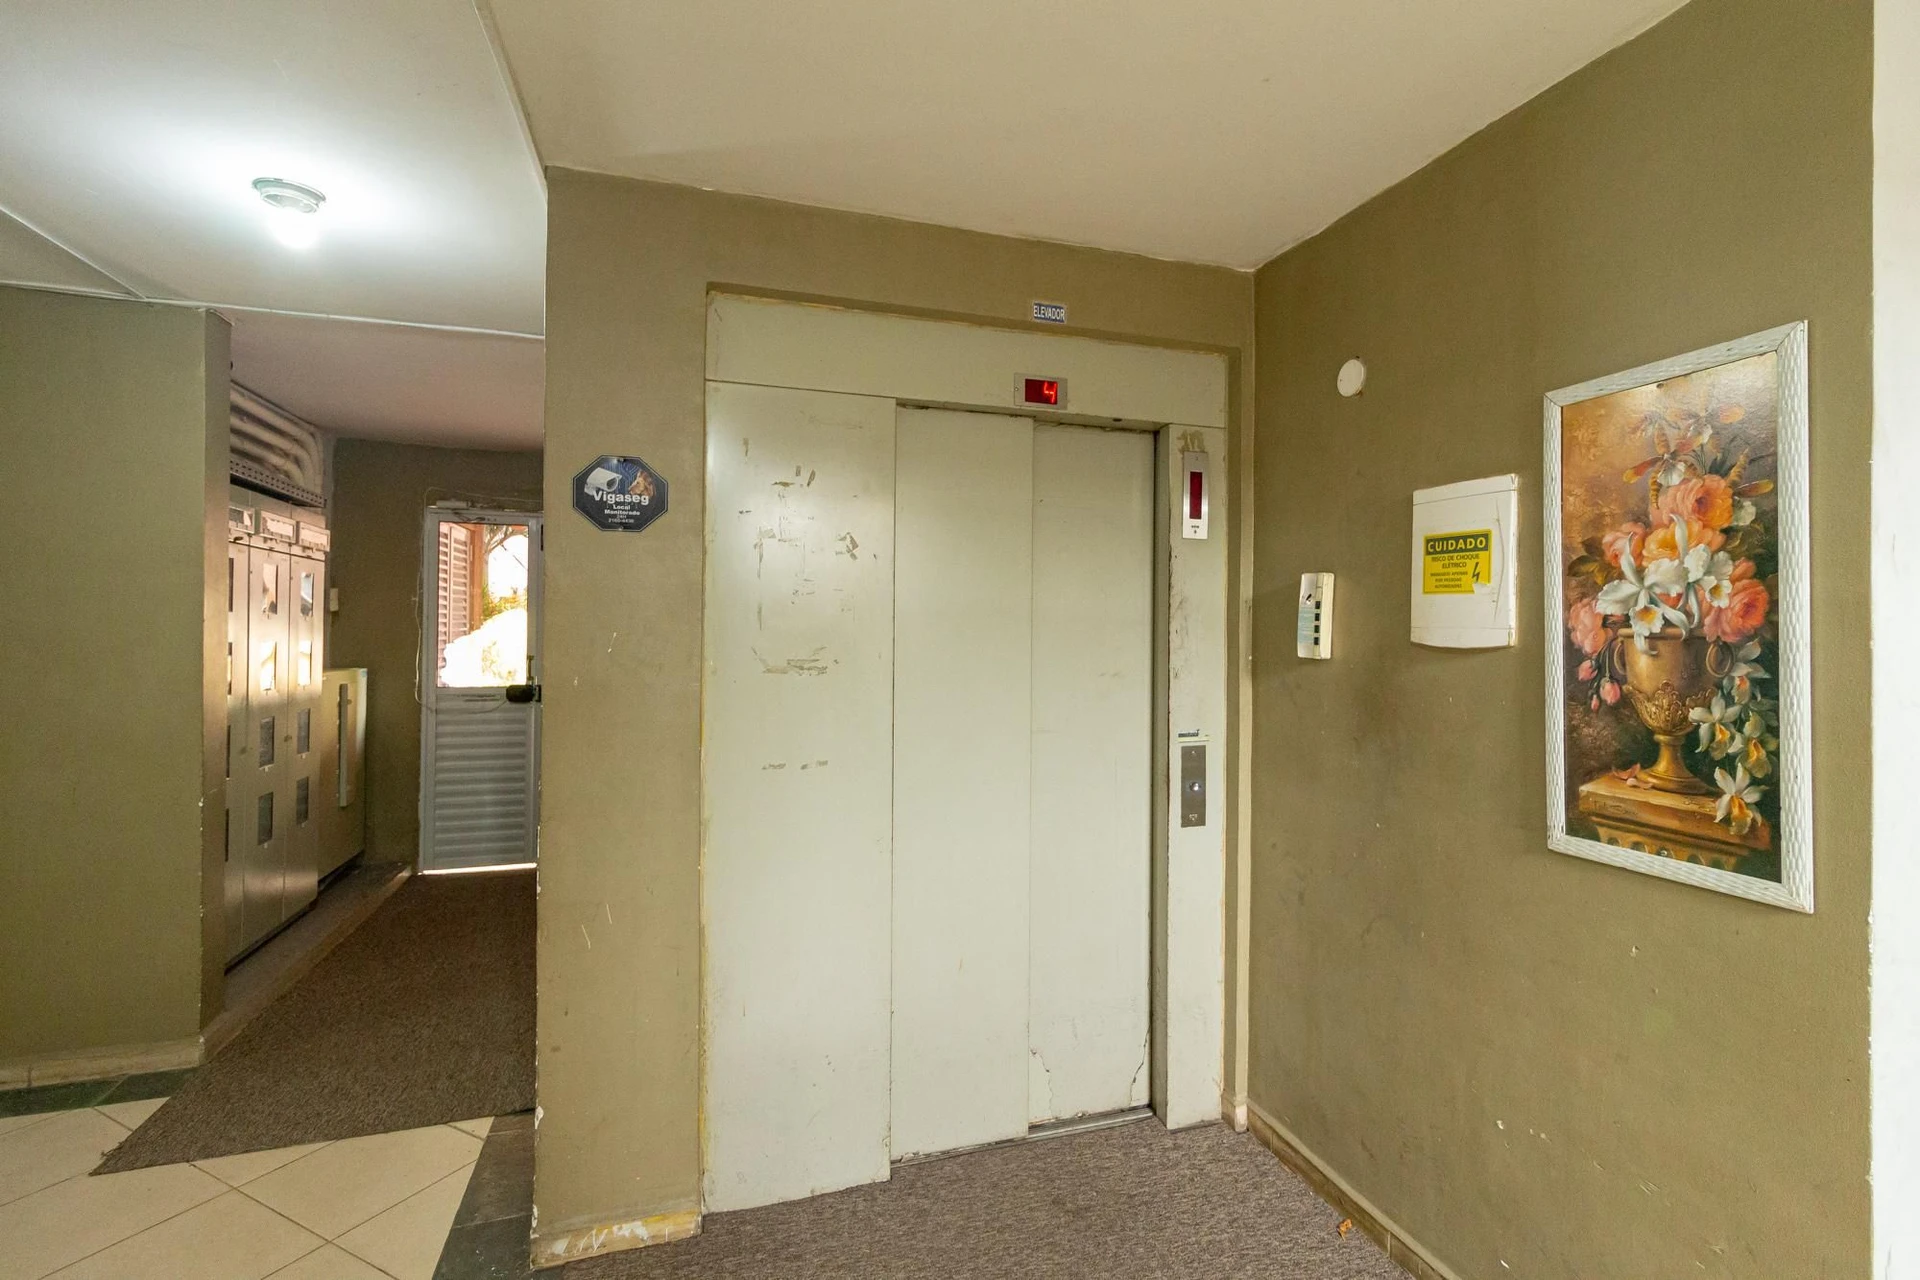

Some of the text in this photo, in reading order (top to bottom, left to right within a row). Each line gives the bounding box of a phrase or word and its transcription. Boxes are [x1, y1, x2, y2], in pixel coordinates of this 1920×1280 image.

[1033, 304, 1065, 320] ELEVADOR
[1044, 380, 1058, 404] 4
[593, 490, 649, 505] Vigaseg
[1427, 537, 1486, 552] CUIDADO
[1455, 553, 1480, 561] CHOQUE
